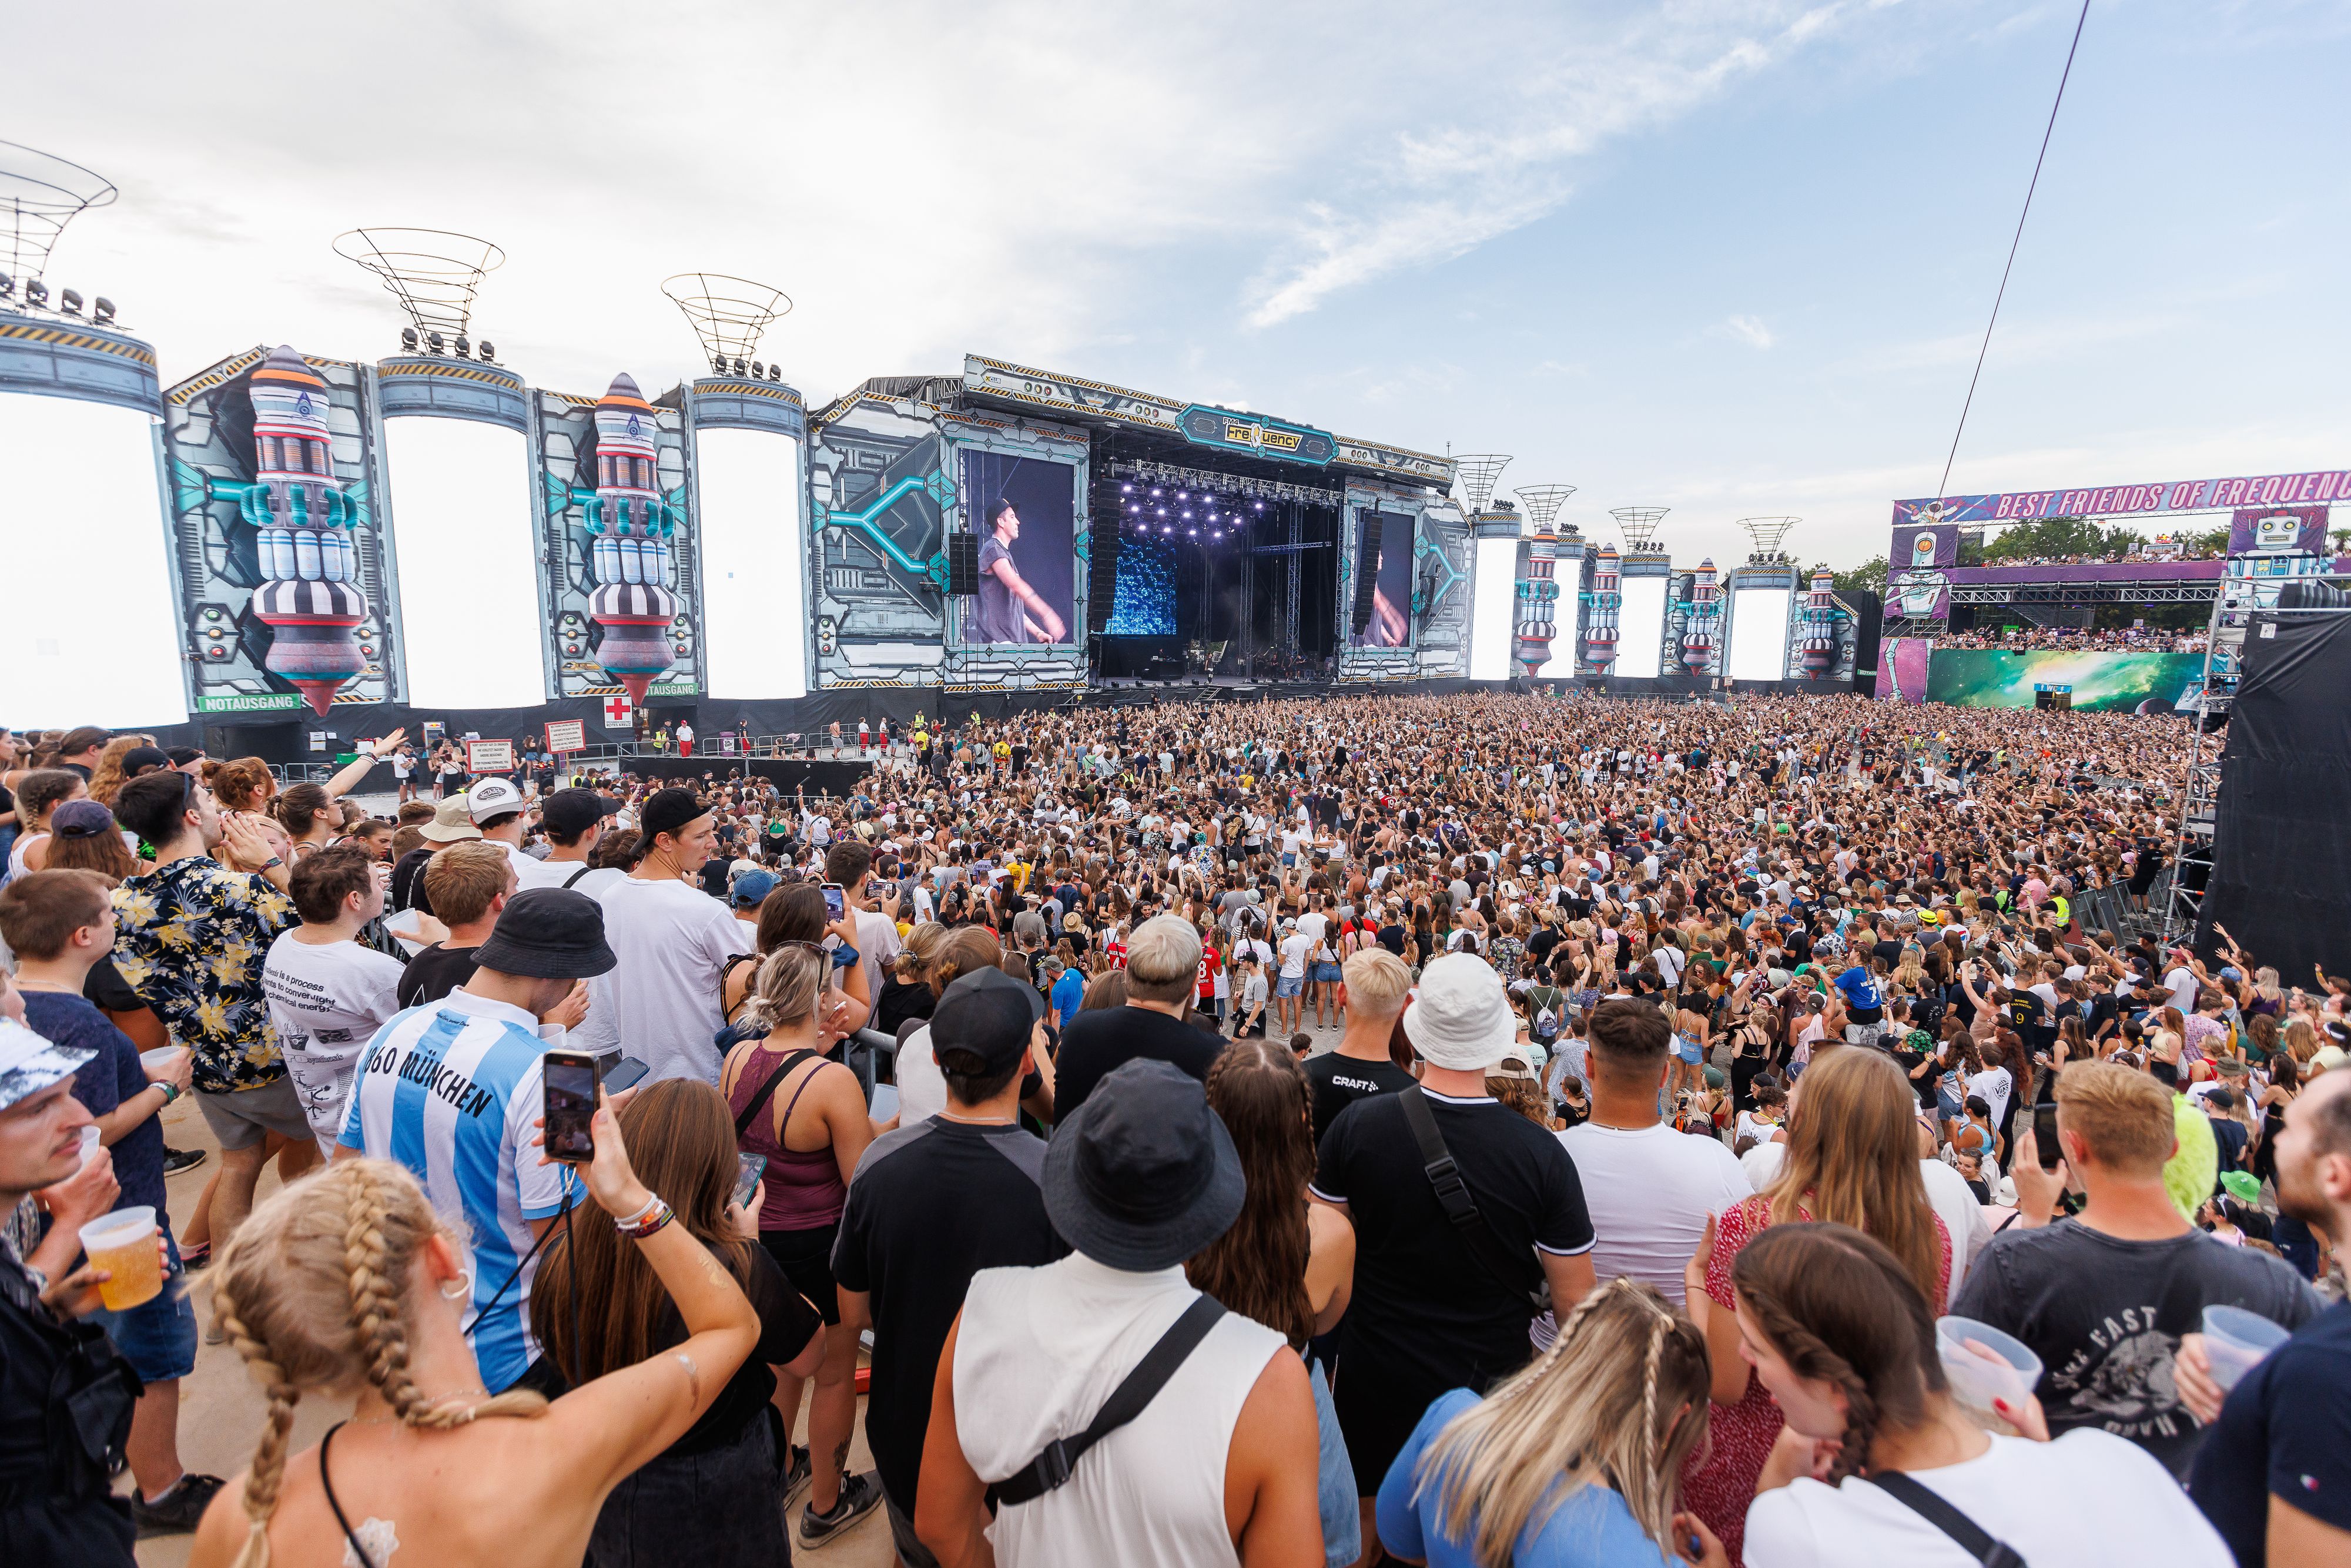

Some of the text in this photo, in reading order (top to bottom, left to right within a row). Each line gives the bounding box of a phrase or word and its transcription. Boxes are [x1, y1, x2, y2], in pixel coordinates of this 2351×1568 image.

[1995, 492, 2055, 518] BEST
[2058, 484, 2163, 515] FRIENDS
[2170, 482, 2205, 508] OF
[205, 696, 294, 711] NOTAUSGANG
[1388, 799, 1394, 809] 19
[1198, 960, 1207, 978] 8
[278, 982, 284, 991] to
[279, 970, 285, 979] is
[290, 977, 324, 992] process
[269, 991, 297, 1007] chemical
[2016, 1013, 2024, 1024] 9
[361, 1046, 397, 1075] 1860
[397, 1049, 494, 1119] MÜNCHEN
[1332, 1075, 1369, 1090] CRAFT
